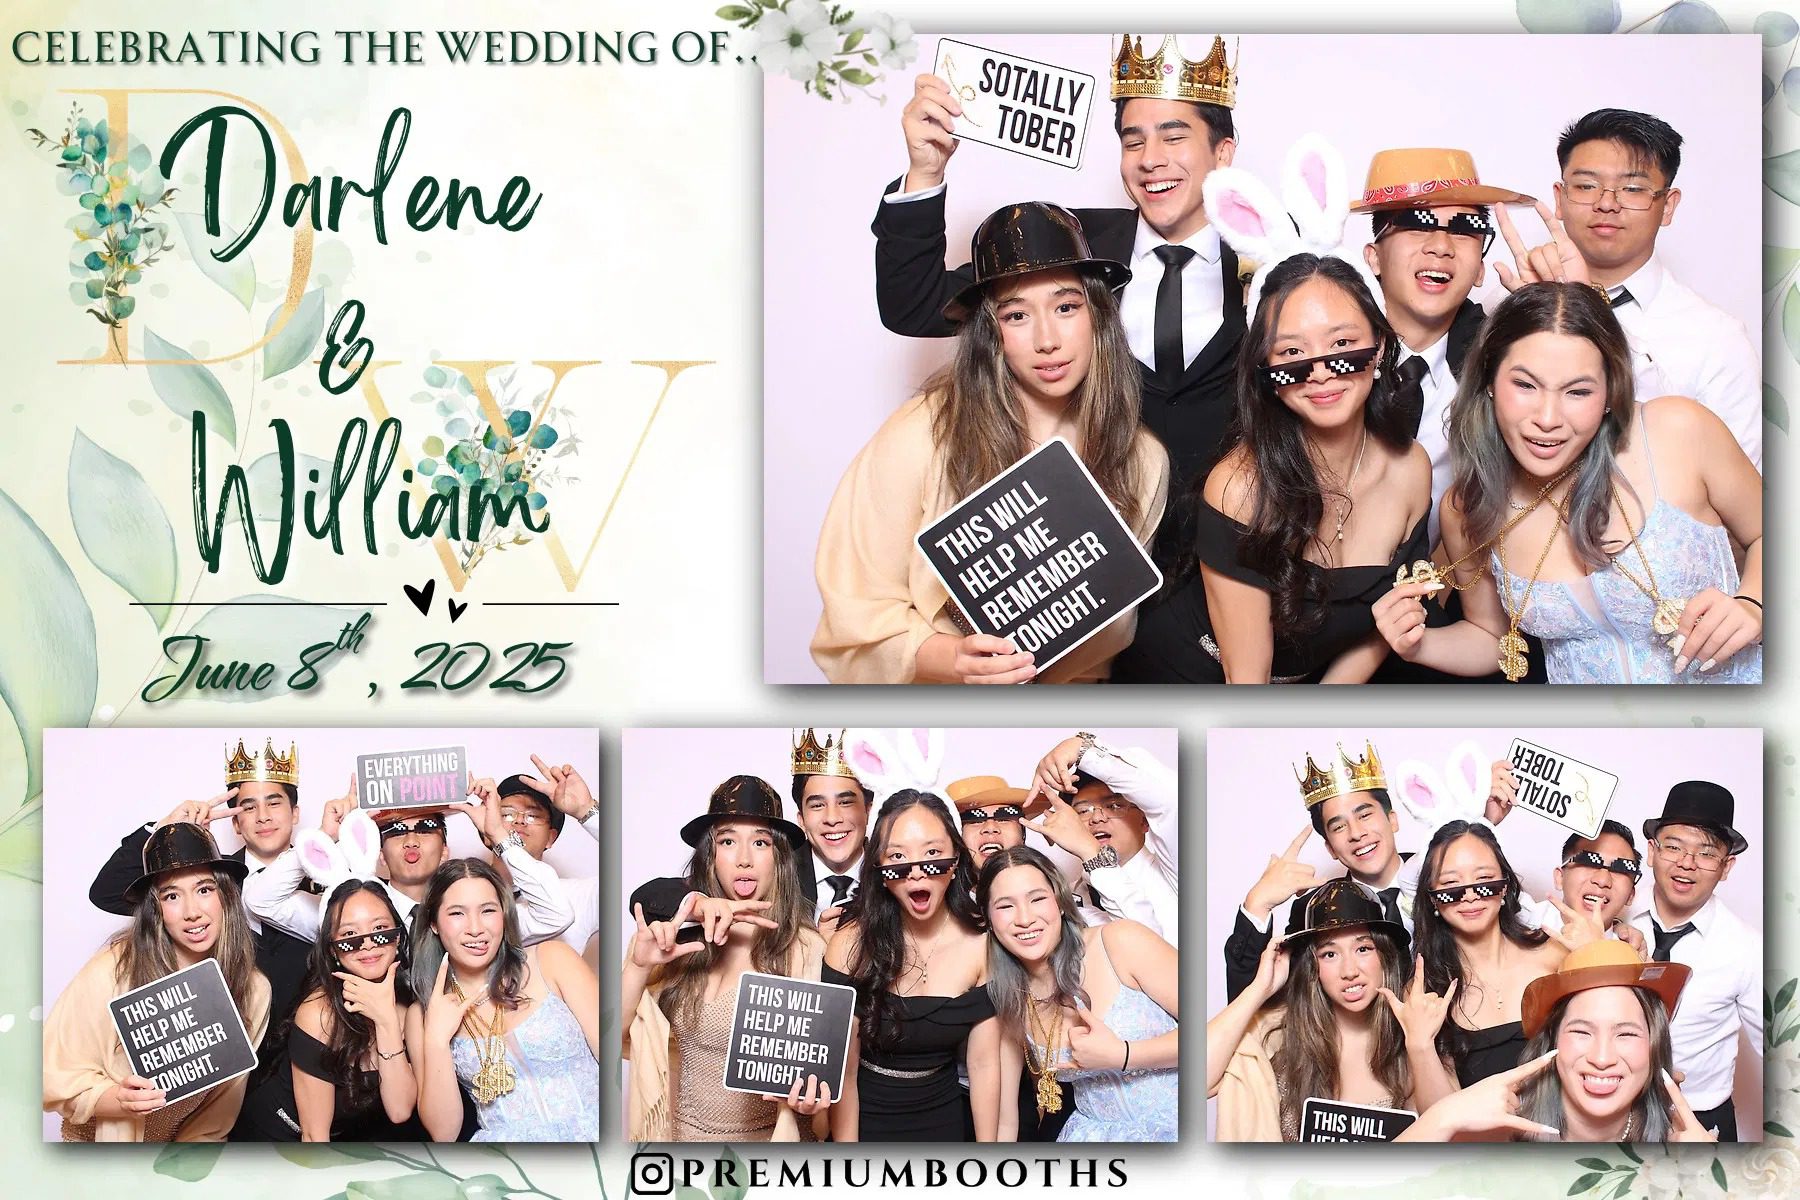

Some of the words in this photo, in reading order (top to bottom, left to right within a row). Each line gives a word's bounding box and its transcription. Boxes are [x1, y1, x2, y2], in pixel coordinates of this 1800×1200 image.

[979, 58, 1085, 116] SOTALLY
[998, 104, 1076, 158] TOBER
[934, 515, 994, 565] THIS
[985, 480, 1048, 532] WILL
[958, 543, 1016, 599] HELP
[1014, 517, 1058, 560] ME
[980, 531, 1108, 631] REMEMBER
[364, 752, 458, 778] EVERYTHING
[1512, 745, 1564, 786] TOBER
[366, 779, 393, 805] ON
[400, 773, 458, 802] POINT
[120, 996, 158, 1026] THIS
[156, 982, 198, 1011] WILL
[748, 984, 784, 1008] THIS
[787, 990, 824, 1014] WILL
[130, 1018, 170, 1050] HELP
[170, 1007, 198, 1032] ME
[743, 1009, 784, 1033] HELP
[786, 1016, 812, 1037] ME
[139, 1022, 228, 1073] REMEMBER
[739, 1034, 829, 1064] REMEMBER
[1313, 1110, 1347, 1133] THIS
[1351, 1115, 1386, 1139] WILL
